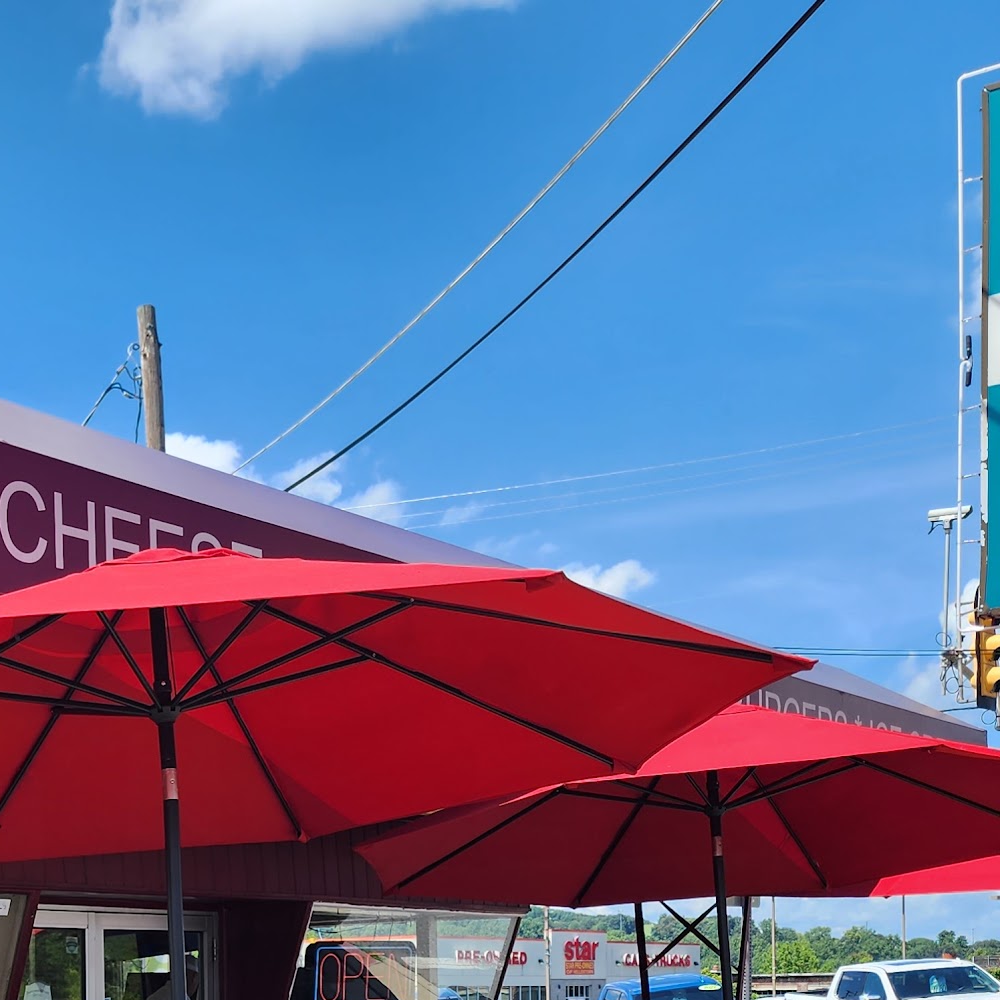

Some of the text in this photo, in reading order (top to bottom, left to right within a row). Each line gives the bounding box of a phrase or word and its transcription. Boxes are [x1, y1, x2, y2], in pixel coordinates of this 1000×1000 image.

[564, 936, 599, 961] star
[455, 950, 528, 965] PRE-OED
[622, 953, 652, 967] CAS
